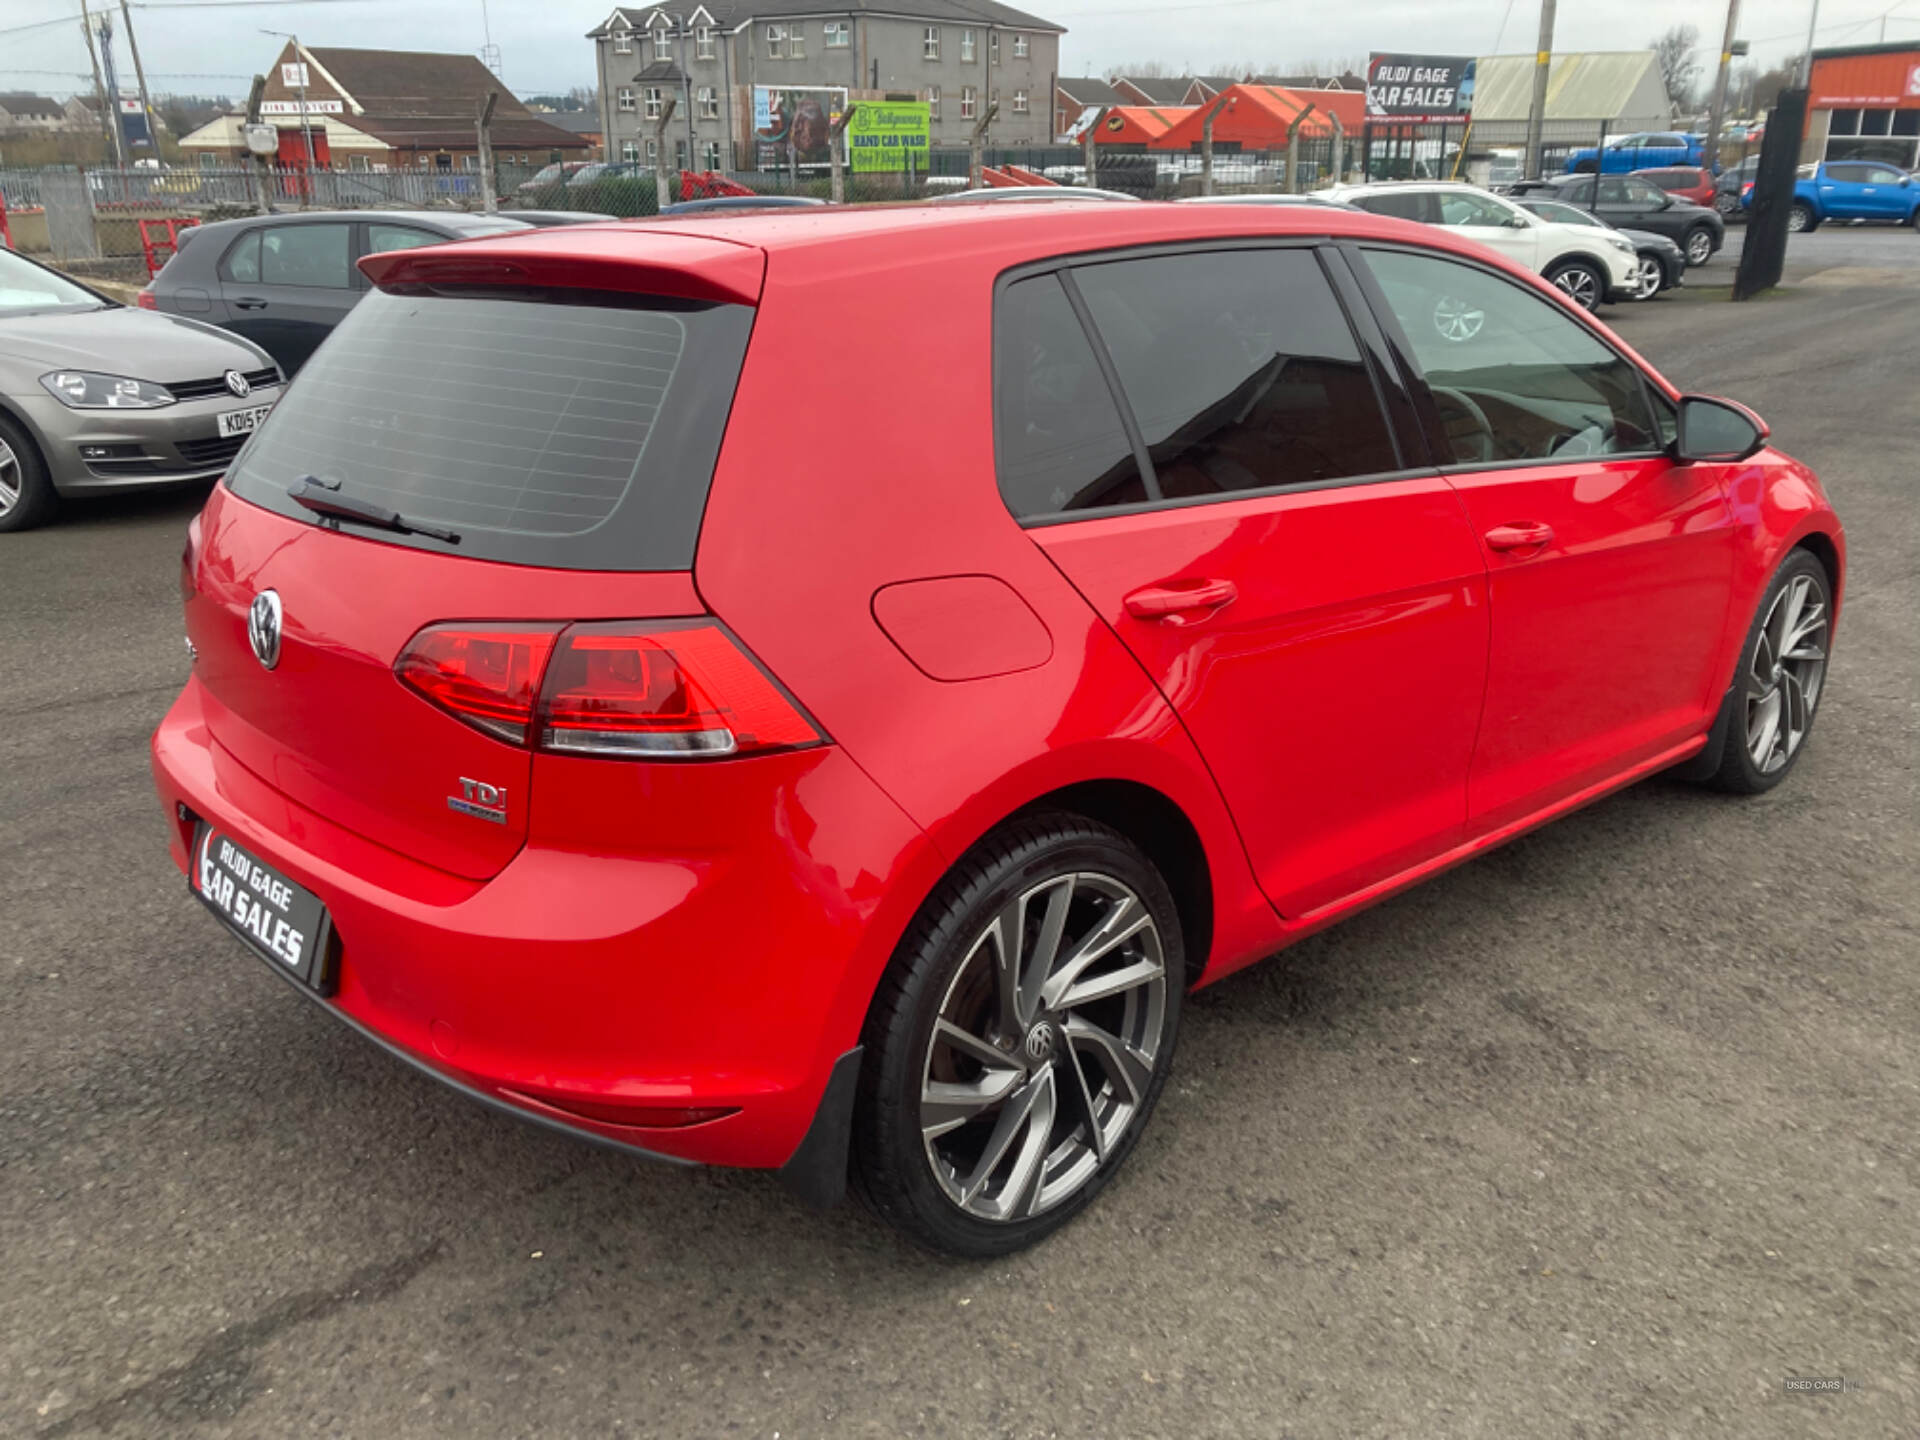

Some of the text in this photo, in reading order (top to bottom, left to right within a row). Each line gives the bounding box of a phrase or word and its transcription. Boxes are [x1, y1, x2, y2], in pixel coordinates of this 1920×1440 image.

[1377, 65, 1451, 83] RUDI GAGE
[1367, 85, 1456, 108] CAR SALES
[853, 134, 926, 147] HAND CAR WASH
[226, 411, 254, 432] KD15
[219, 840, 292, 912] RUDI GAGE
[202, 858, 304, 966] CAR SALES
